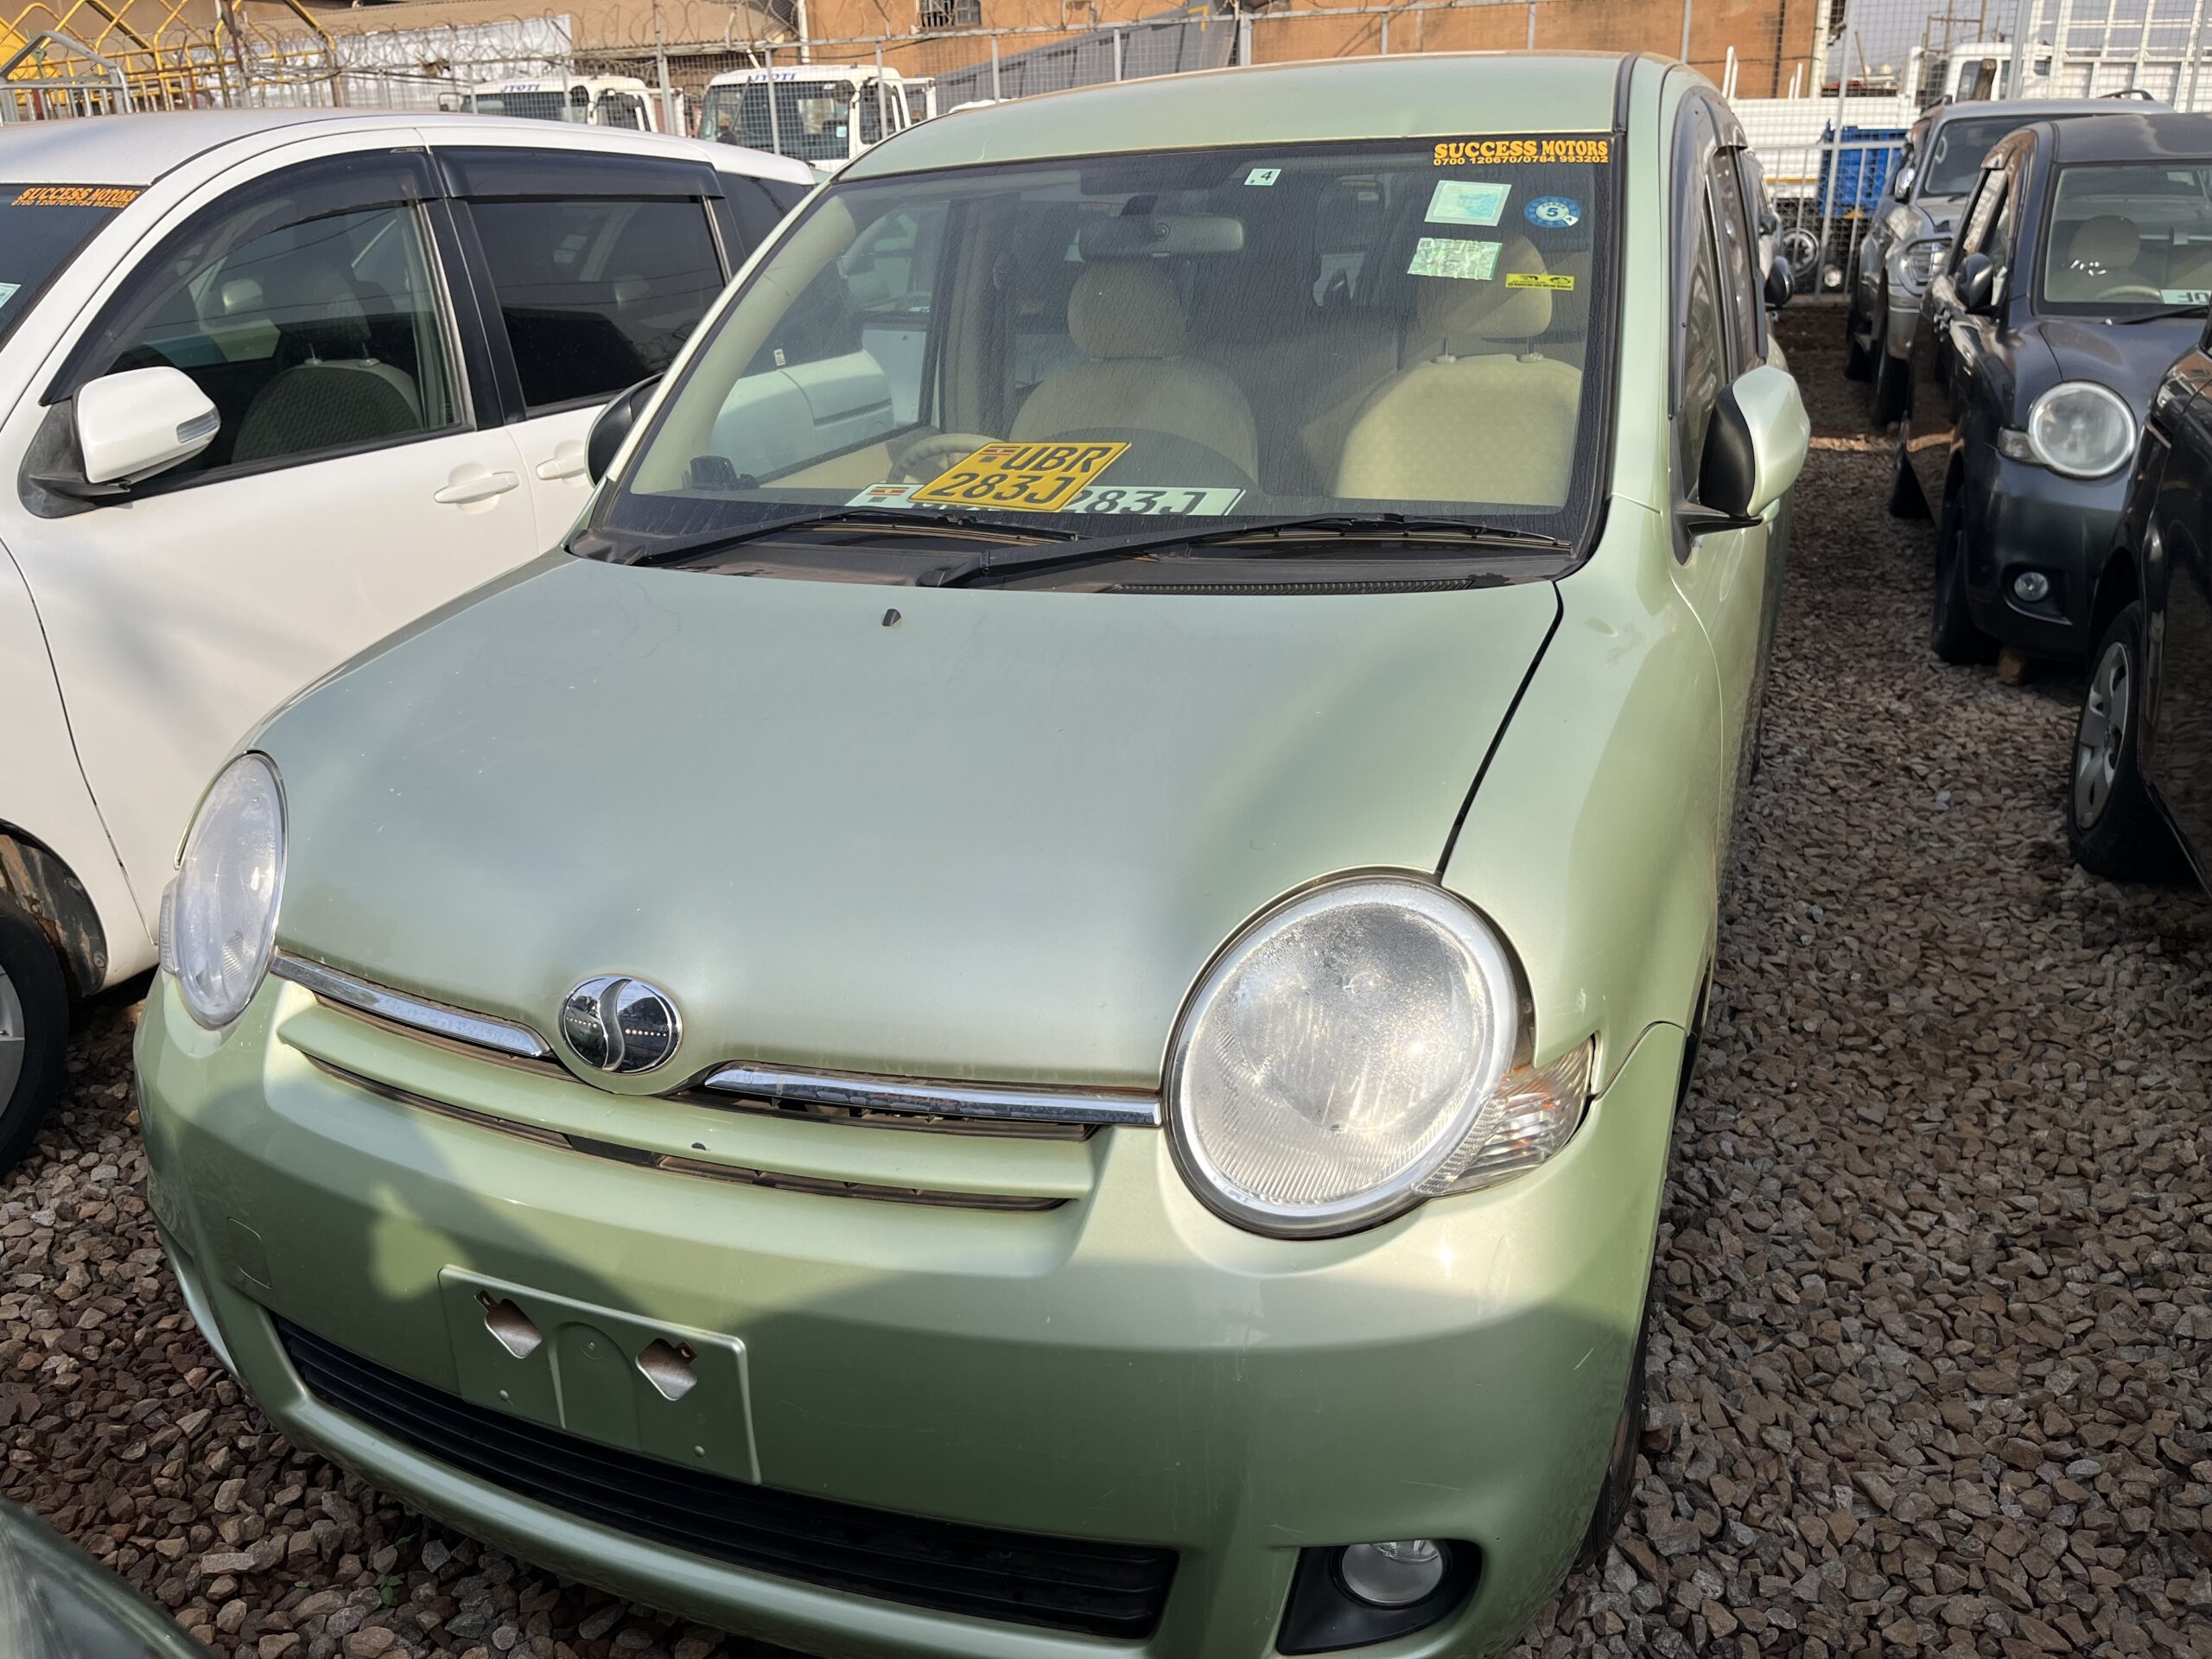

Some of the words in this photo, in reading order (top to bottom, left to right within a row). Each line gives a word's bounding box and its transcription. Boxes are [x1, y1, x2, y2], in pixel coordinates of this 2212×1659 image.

[1434, 140, 1537, 159] SUCCESS
[1541, 140, 1608, 156] MOTORS
[1433, 157, 1465, 166] 0700
[1469, 155, 1556, 164] 120670/0784
[1261, 171, 1273, 181] 4
[17, 188, 93, 200] SUCCESS
[86, 188, 140, 202] MOTORS
[1547, 207, 1559, 217] 5
[1001, 446, 1113, 474] UBR
[927, 472, 1077, 505] 283J
